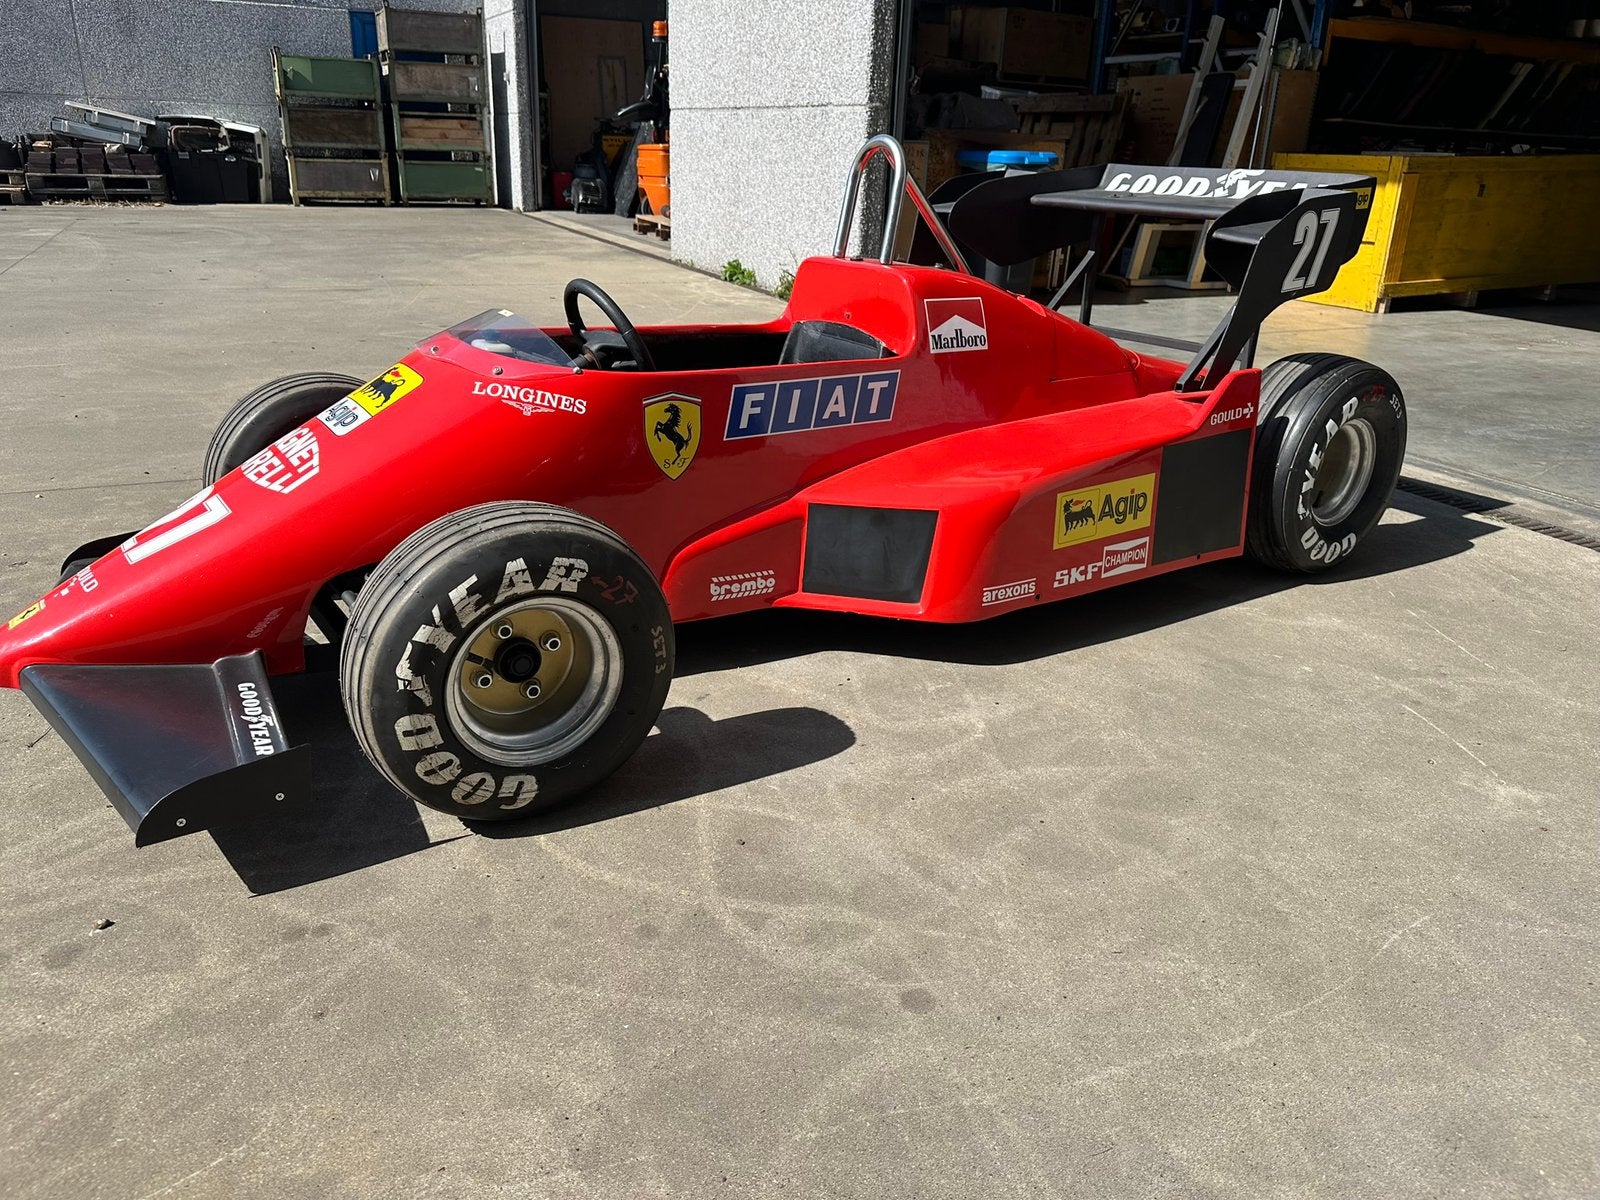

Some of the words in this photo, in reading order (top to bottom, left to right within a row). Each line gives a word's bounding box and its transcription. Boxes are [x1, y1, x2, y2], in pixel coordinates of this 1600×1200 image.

[1280, 207, 1341, 293] 27
[929, 328, 987, 351] Marlboro
[471, 381, 588, 415] LONGINES
[739, 380, 889, 430] FIAT
[1210, 407, 1243, 426] GOULD
[1098, 488, 1148, 525] Agip
[1105, 548, 1146, 568] CHAMPION
[709, 576, 776, 597] brembo
[1053, 562, 1103, 588] SKF
[982, 581, 1036, 602] arexons
